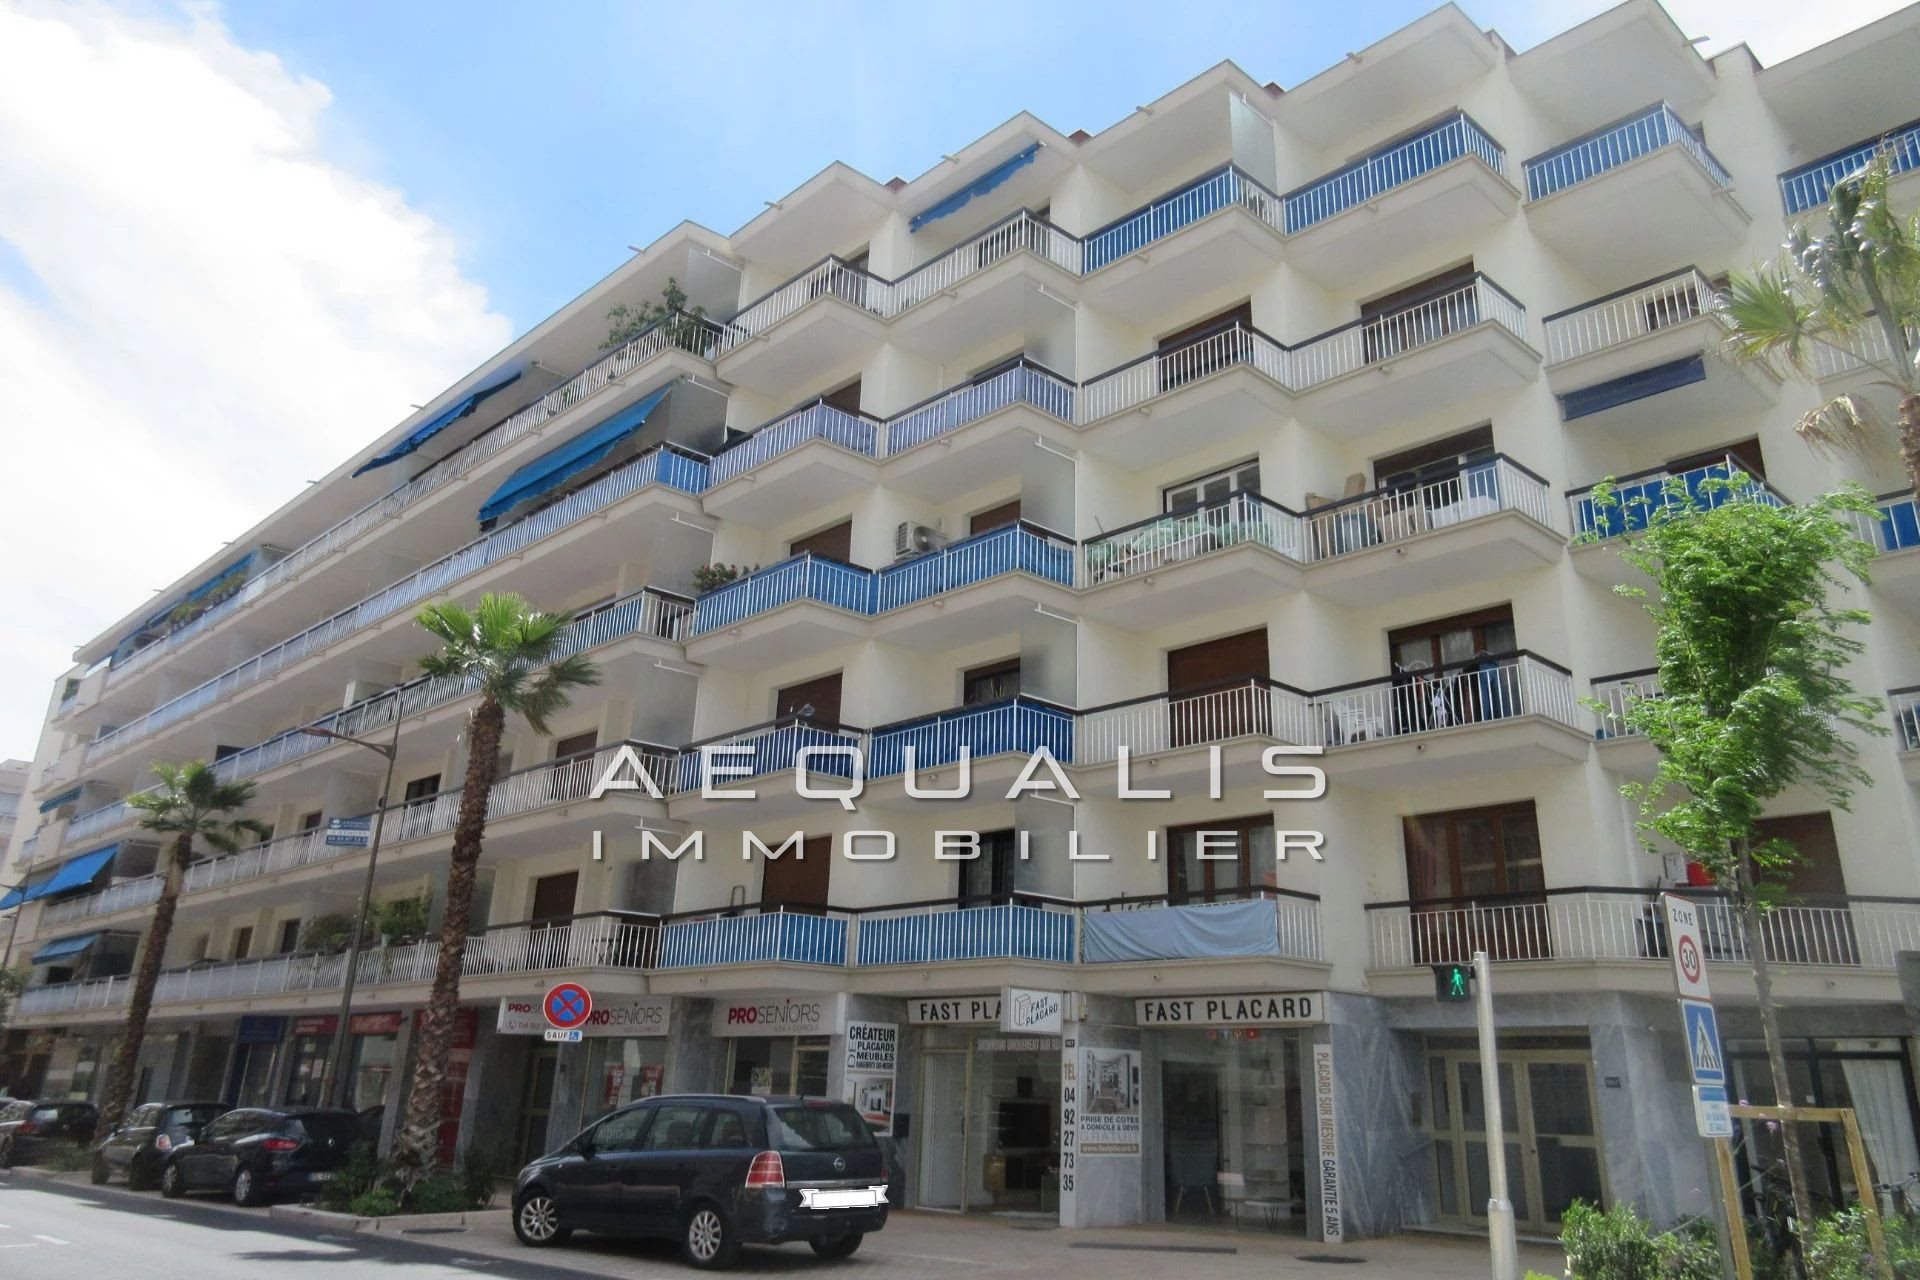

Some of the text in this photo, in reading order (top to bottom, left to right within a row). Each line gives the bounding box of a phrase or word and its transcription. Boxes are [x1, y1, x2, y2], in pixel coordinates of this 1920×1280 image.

[1672, 908, 1693, 926] ZONE
[1683, 948, 1697, 969] 30
[920, 1002, 960, 1021] FAST
[1030, 996, 1049, 1014] FAST
[1145, 997, 1312, 1022] FAST PLACARD
[1025, 1003, 1058, 1027] PLACARD
[547, 1031, 568, 1039] SAUF
[850, 1023, 895, 1042] CRÉATEUR
[857, 1041, 895, 1052] PLACARDS
[857, 1052, 895, 1062] MEUBLES
[1064, 1059, 1076, 1080] TÉL
[1064, 1087, 1075, 1103] 04
[1064, 1109, 1075, 1125] 92
[1080, 1115, 1140, 1124] PRISE DE COTES
[1087, 1123, 1115, 1131] DOMICILE
[1064, 1131, 1075, 1146] 27
[1316, 1052, 1340, 1236] PLACARD SUR MESURE GARANTIE 5 ANS
[1063, 1152, 1074, 1168] 73
[1063, 1174, 1074, 1191] 35
